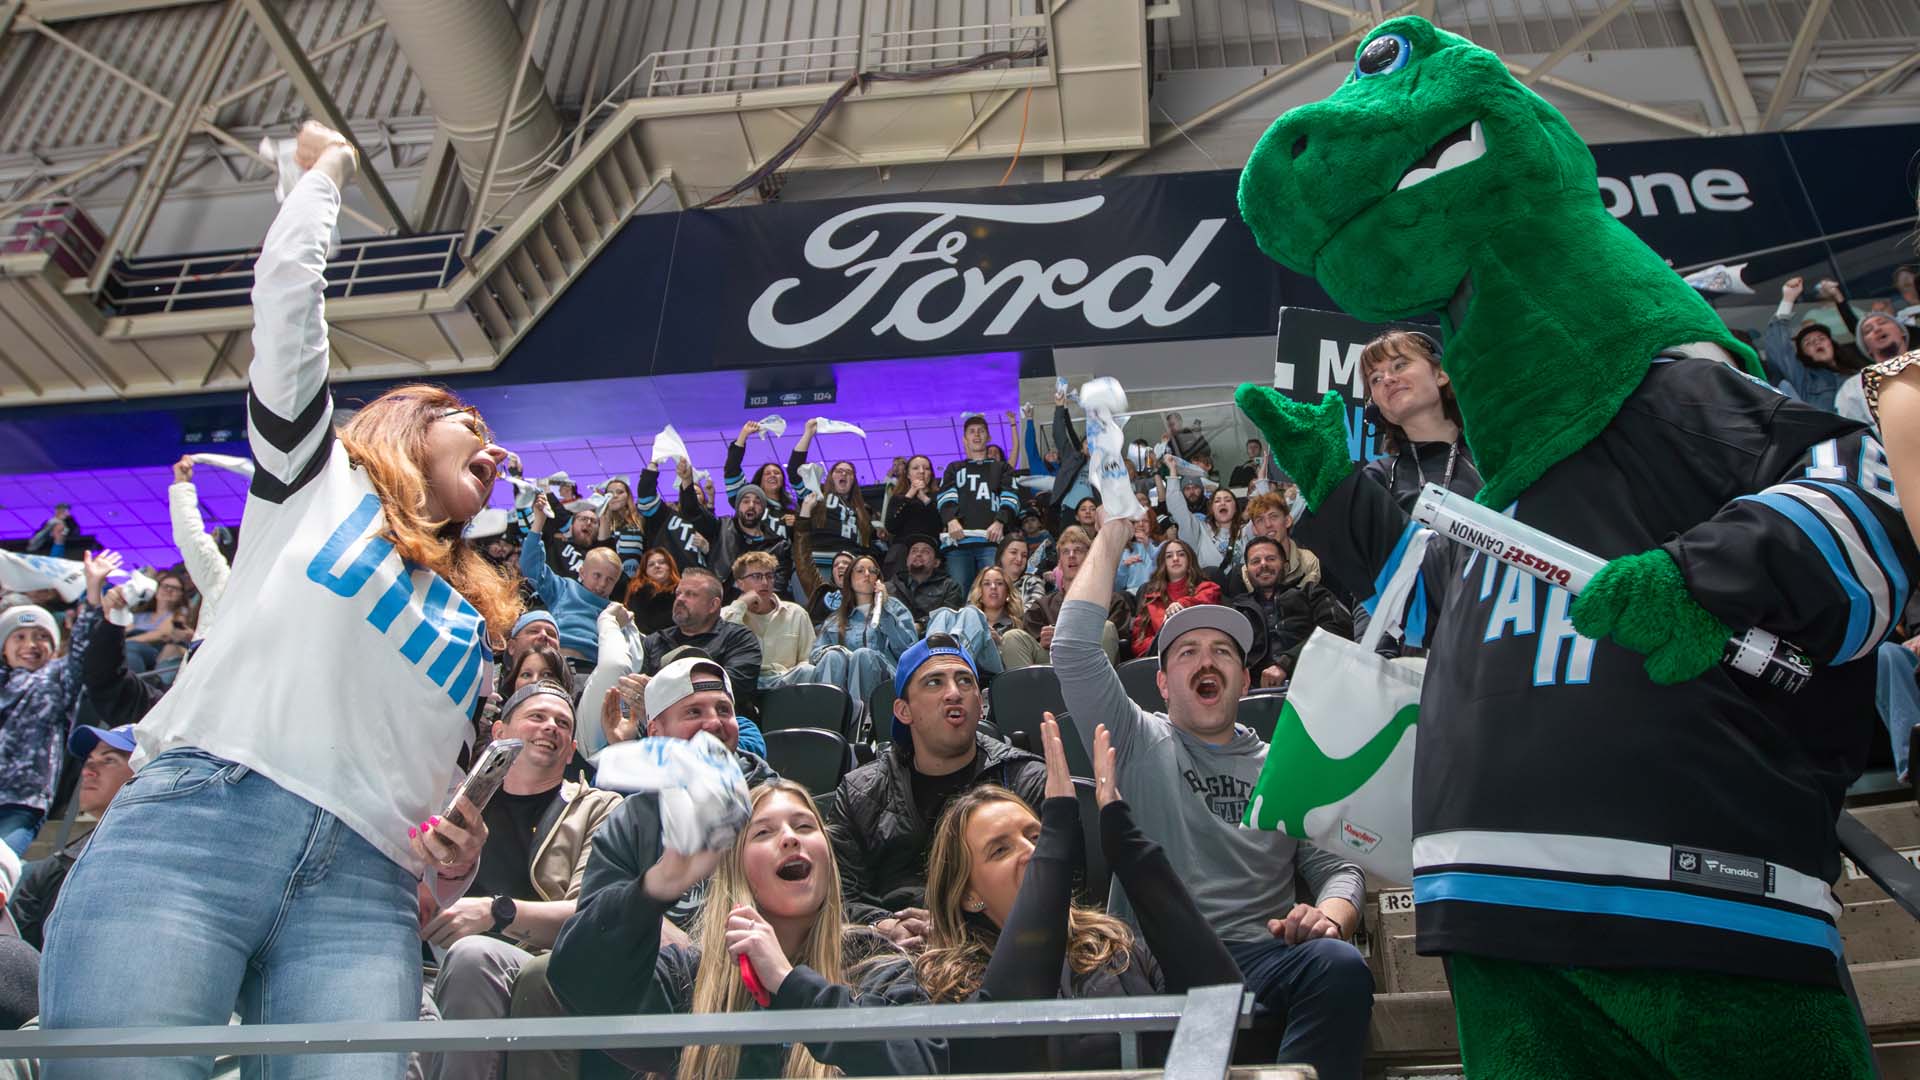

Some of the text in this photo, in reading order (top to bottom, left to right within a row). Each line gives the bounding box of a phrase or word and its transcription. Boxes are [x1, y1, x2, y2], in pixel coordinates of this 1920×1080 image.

[748, 195, 1226, 348] Ford
[1317, 338, 1366, 399] M
[750, 396, 768, 405] 103
[813, 392, 832, 401] 104
[956, 467, 1000, 512] UTAH
[1449, 519, 1571, 587] blast! CANNON
[1720, 864, 1759, 879] Fanatics
[1387, 895, 1414, 910] RO
